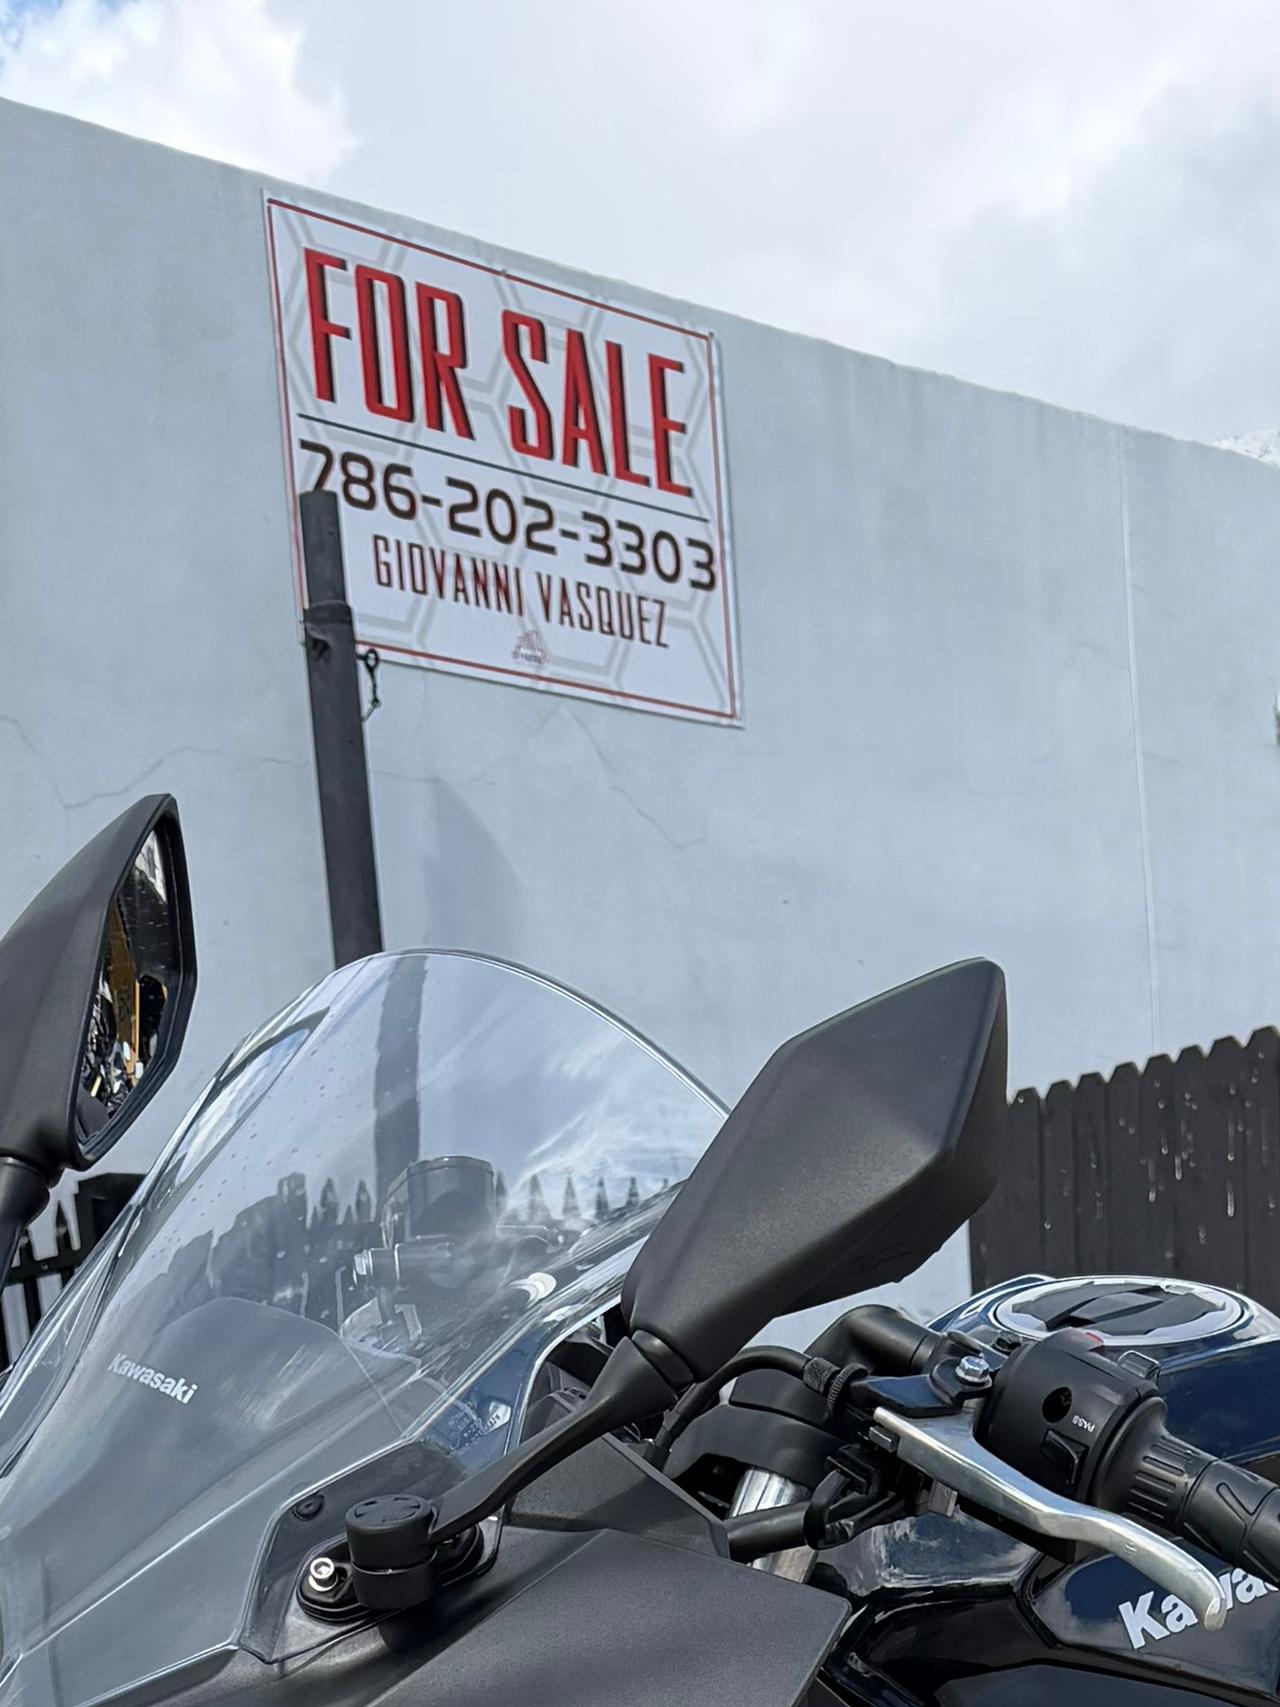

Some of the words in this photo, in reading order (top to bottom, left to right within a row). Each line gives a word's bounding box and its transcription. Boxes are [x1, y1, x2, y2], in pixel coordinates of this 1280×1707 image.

[303, 246, 476, 441] FOR
[501, 309, 693, 498] SALE
[300, 438, 717, 593] 786-202-3303
[373, 533, 526, 618] GIOVANNI
[536, 570, 670, 649] VASQUEZ
[107, 1352, 199, 1404] Kawasaki
[1071, 1414, 1096, 1433] PASS
